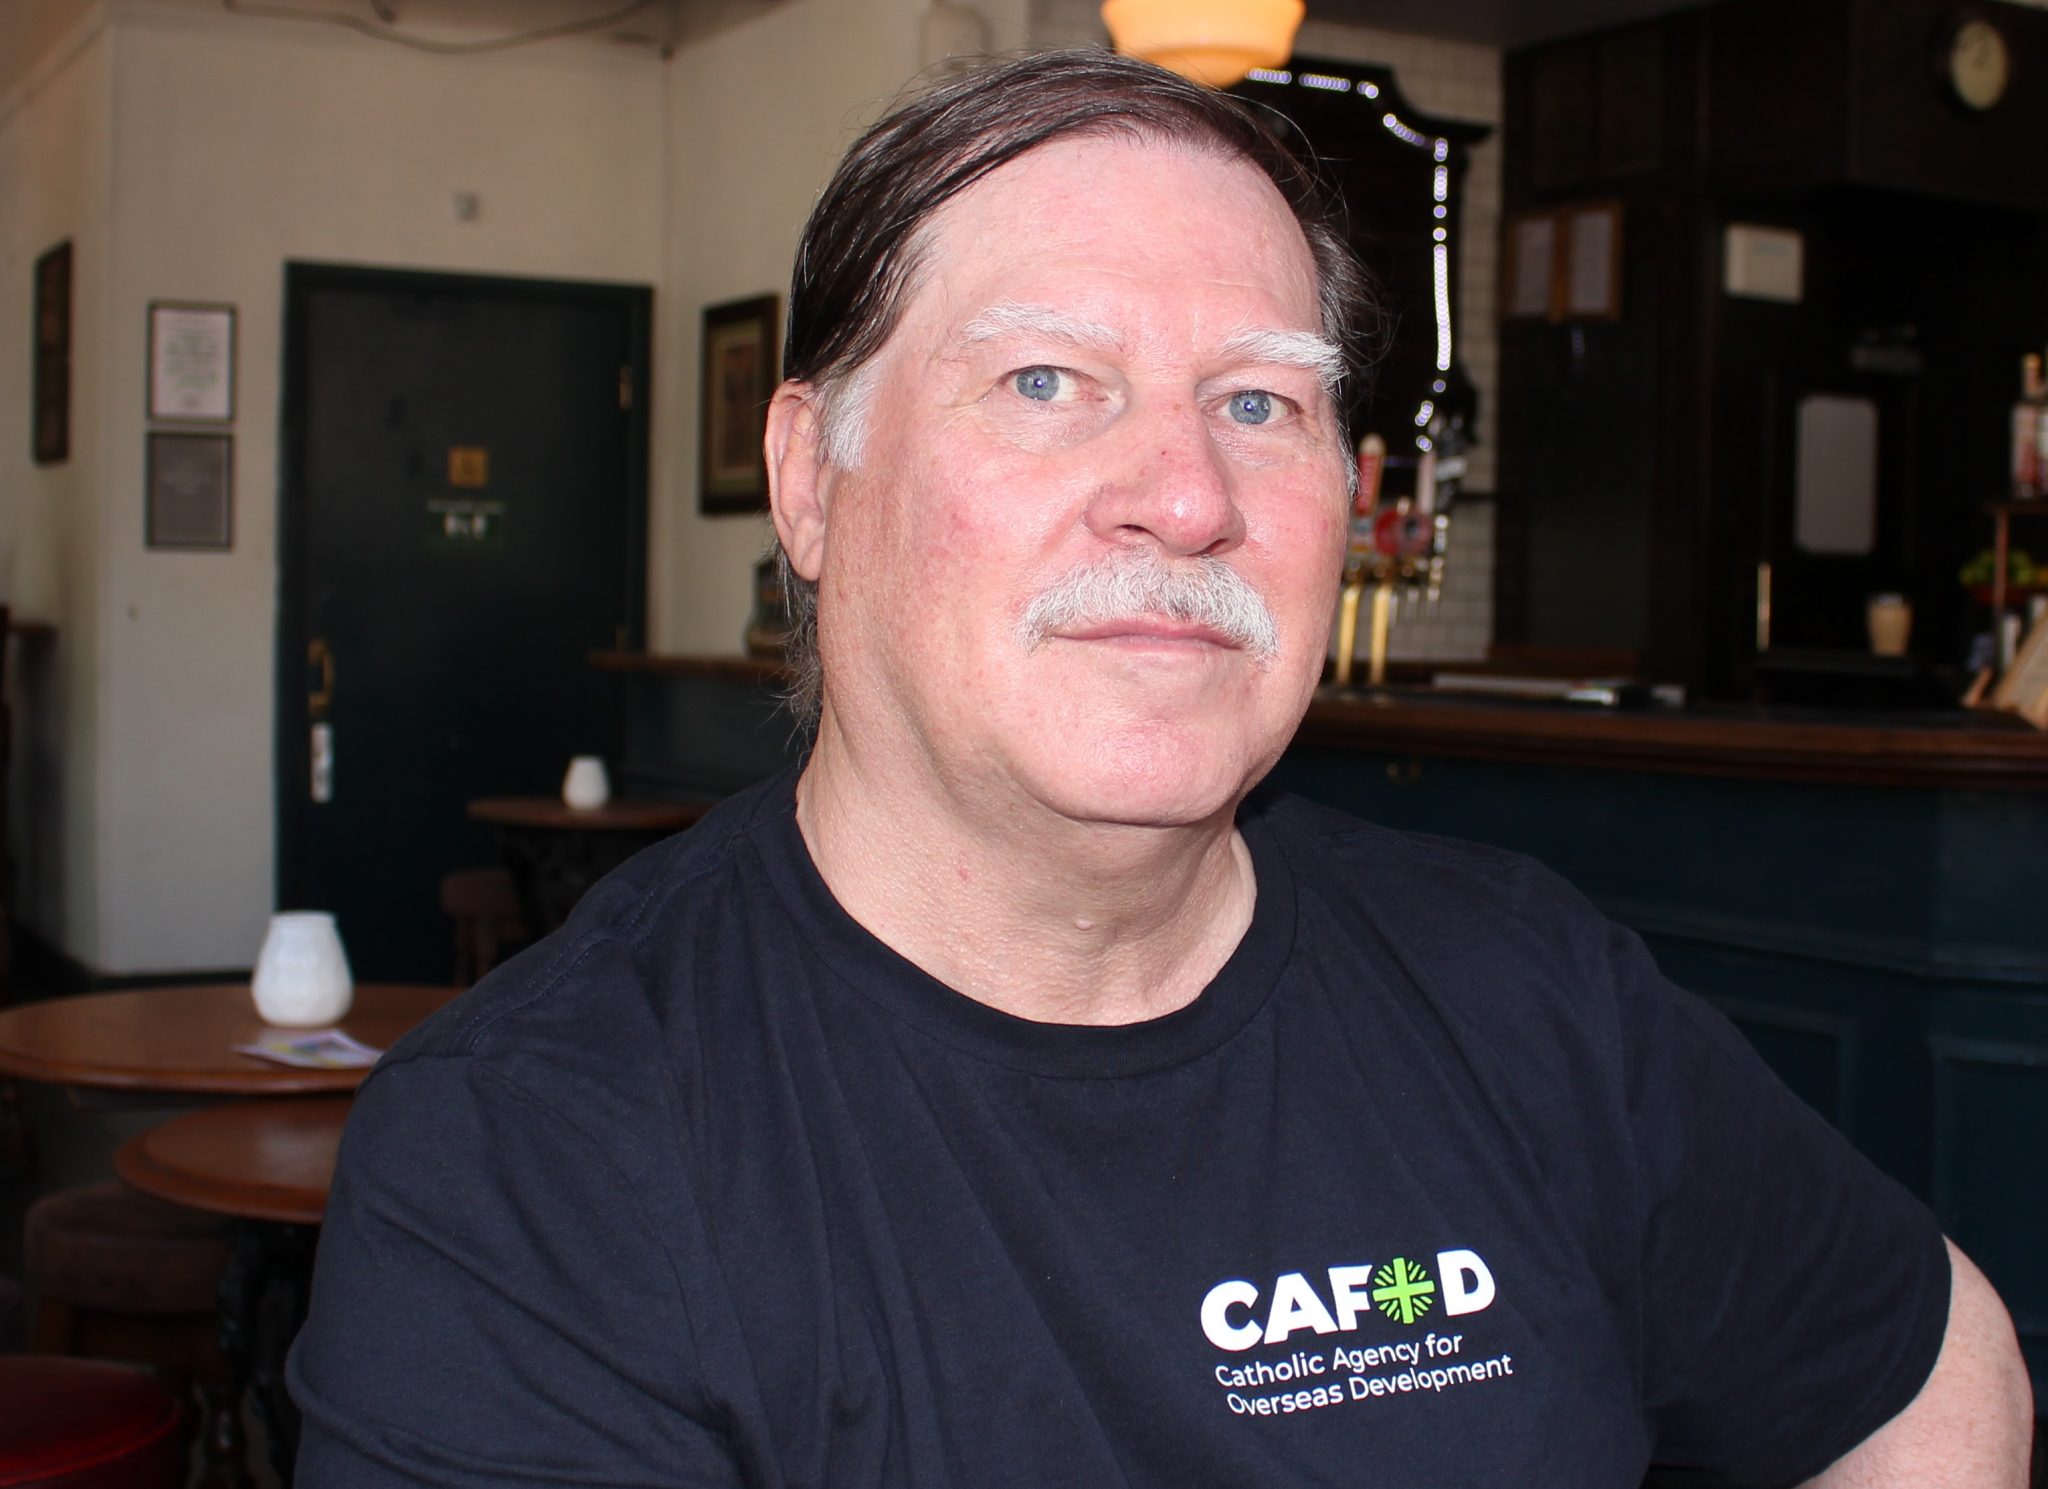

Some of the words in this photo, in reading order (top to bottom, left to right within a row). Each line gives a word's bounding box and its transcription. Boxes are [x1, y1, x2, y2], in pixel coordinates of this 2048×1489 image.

[1214, 1352, 1325, 1387] Catholic
[1332, 1345, 1420, 1374] Agency
[1424, 1332, 1463, 1358] for
[1226, 1383, 1344, 1416] Overseas
[1348, 1354, 1514, 1401] Development
